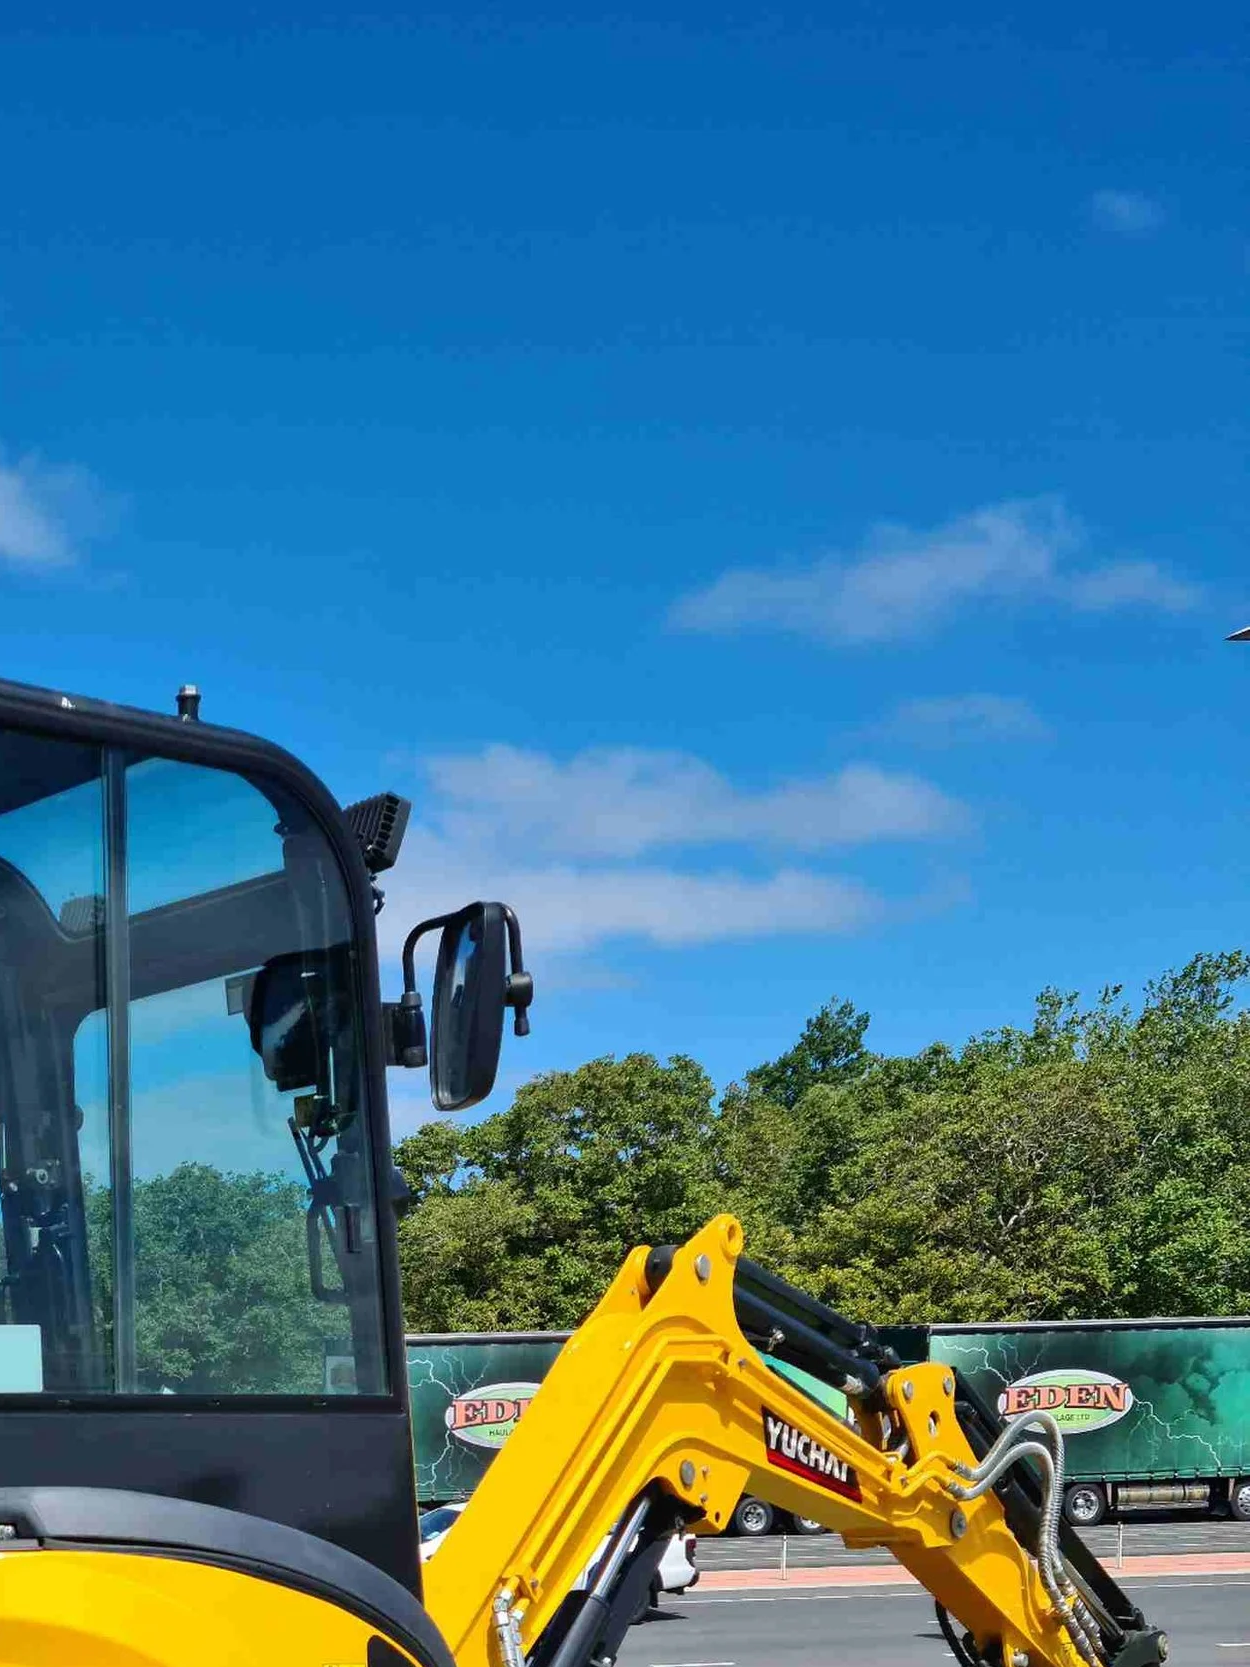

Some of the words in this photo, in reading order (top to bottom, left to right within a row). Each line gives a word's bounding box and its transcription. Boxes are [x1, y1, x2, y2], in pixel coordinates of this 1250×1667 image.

[451, 1398, 533, 1430] ED
[1002, 1383, 1129, 1416] EDEN
[767, 1416, 848, 1482] YUCHAI
